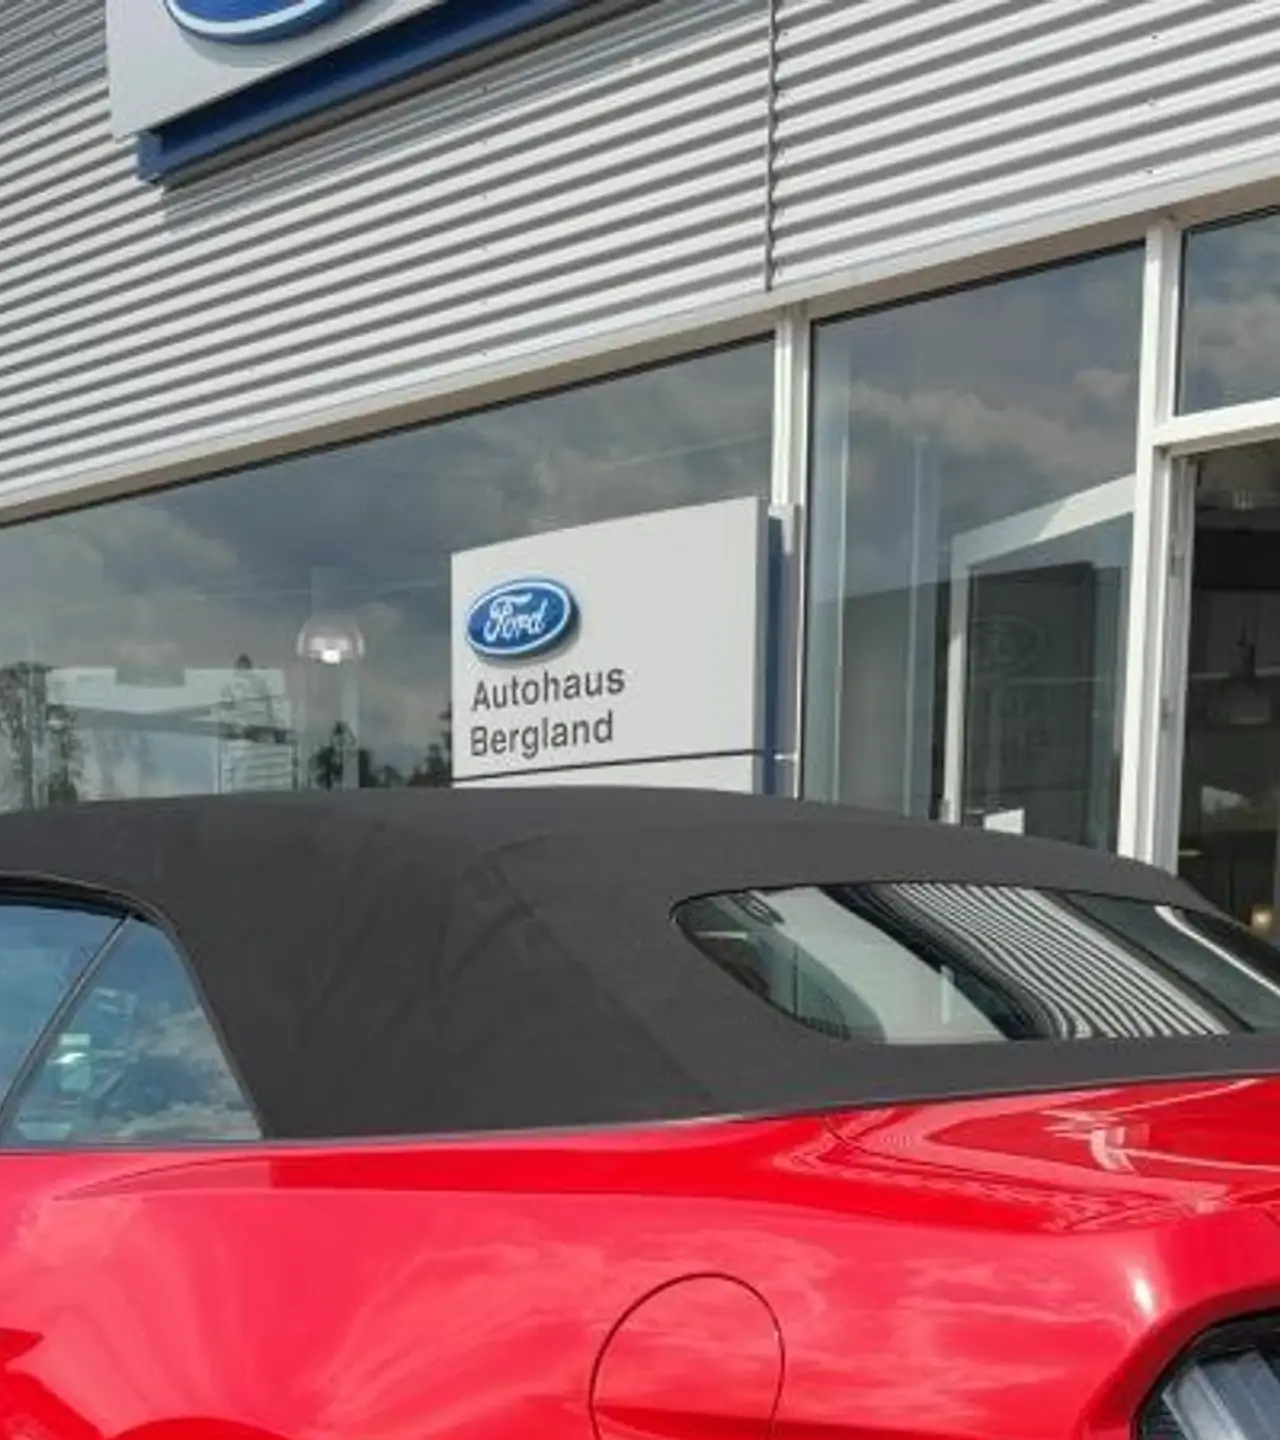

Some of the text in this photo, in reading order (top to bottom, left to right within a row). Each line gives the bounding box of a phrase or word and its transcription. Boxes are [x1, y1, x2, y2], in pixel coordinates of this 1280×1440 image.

[483, 592, 547, 643] Ford
[472, 667, 626, 711] Autohaus
[471, 708, 613, 759] Bergland
